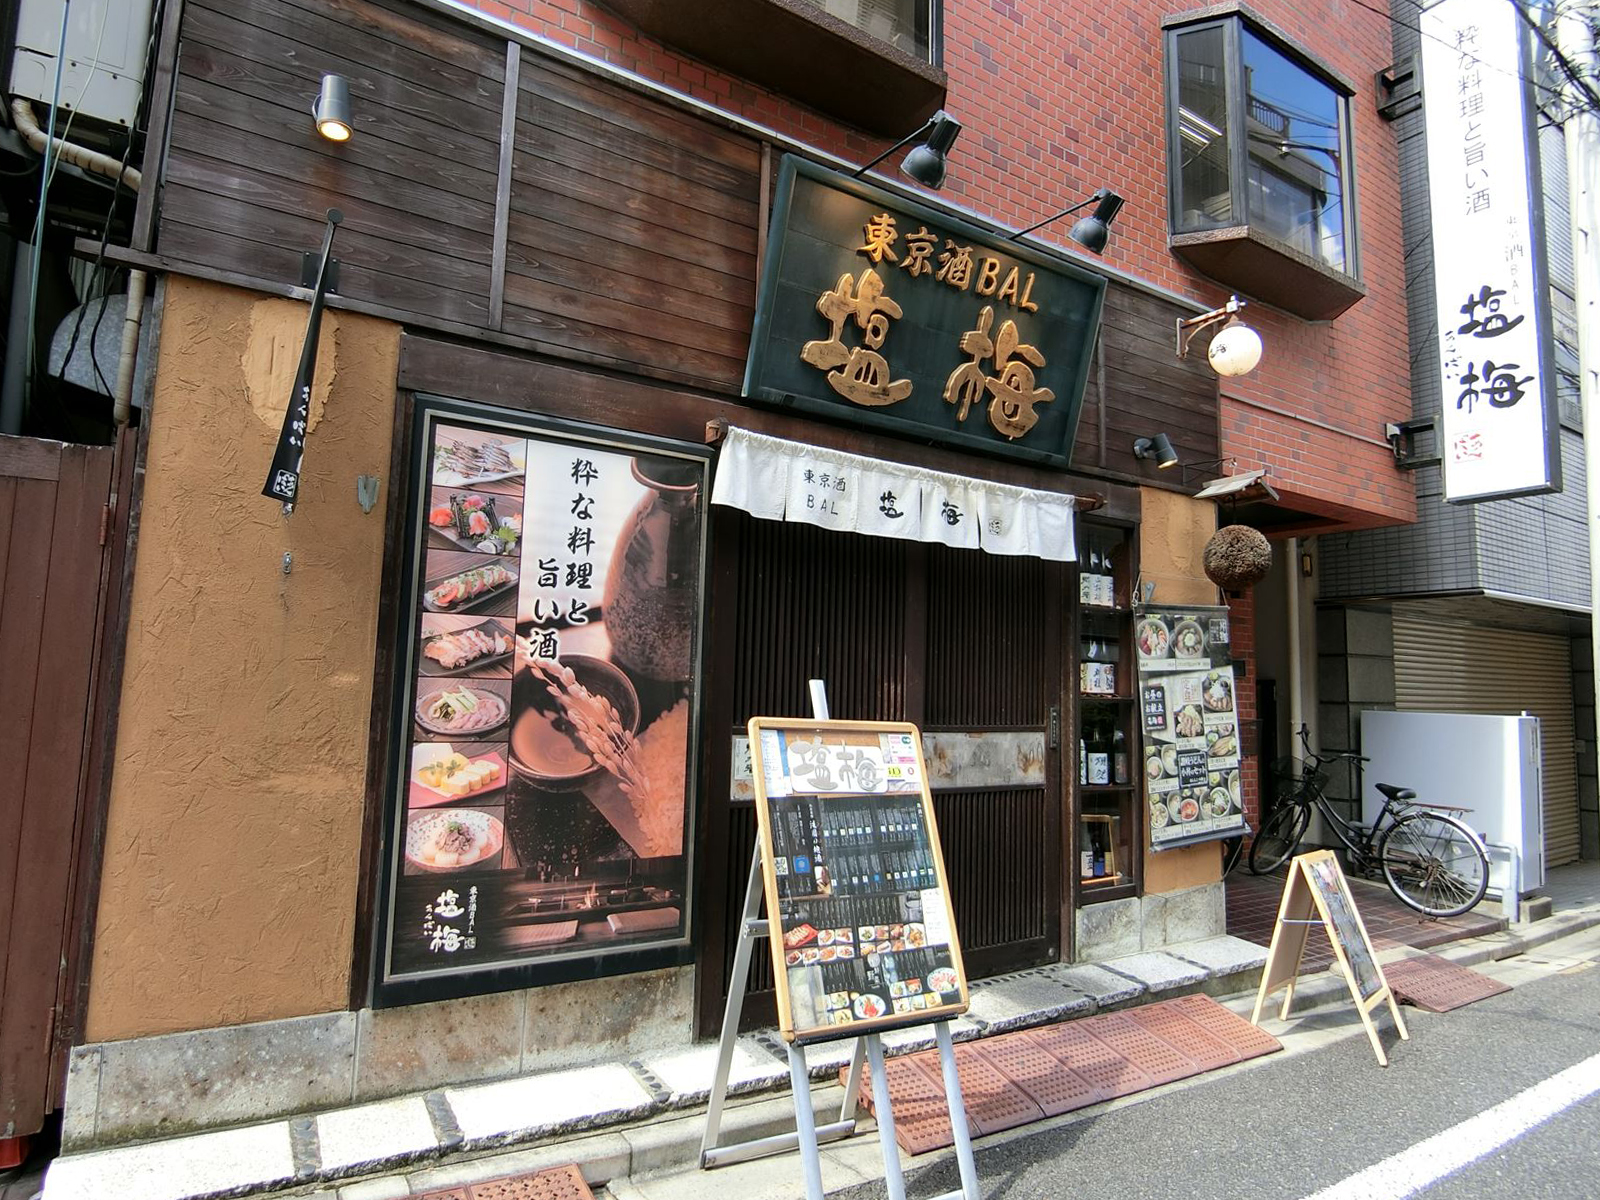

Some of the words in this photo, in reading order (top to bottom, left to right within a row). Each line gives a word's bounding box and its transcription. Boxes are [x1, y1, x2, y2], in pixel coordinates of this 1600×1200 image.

[1454, 24, 1491, 216] 粋な料理と旨い酒
[856, 212, 1039, 313] 東京酒BAL
[800, 268, 1056, 441] 塩梅
[1456, 284, 1536, 414] 塩梅
[803, 468, 847, 493] 東京酒
[806, 495, 840, 516] BAL
[564, 457, 599, 624] 粋な料理と
[528, 557, 560, 661] 旨い酒
[787, 735, 884, 792] 塩梅
[430, 889, 466, 953] 塩梅
